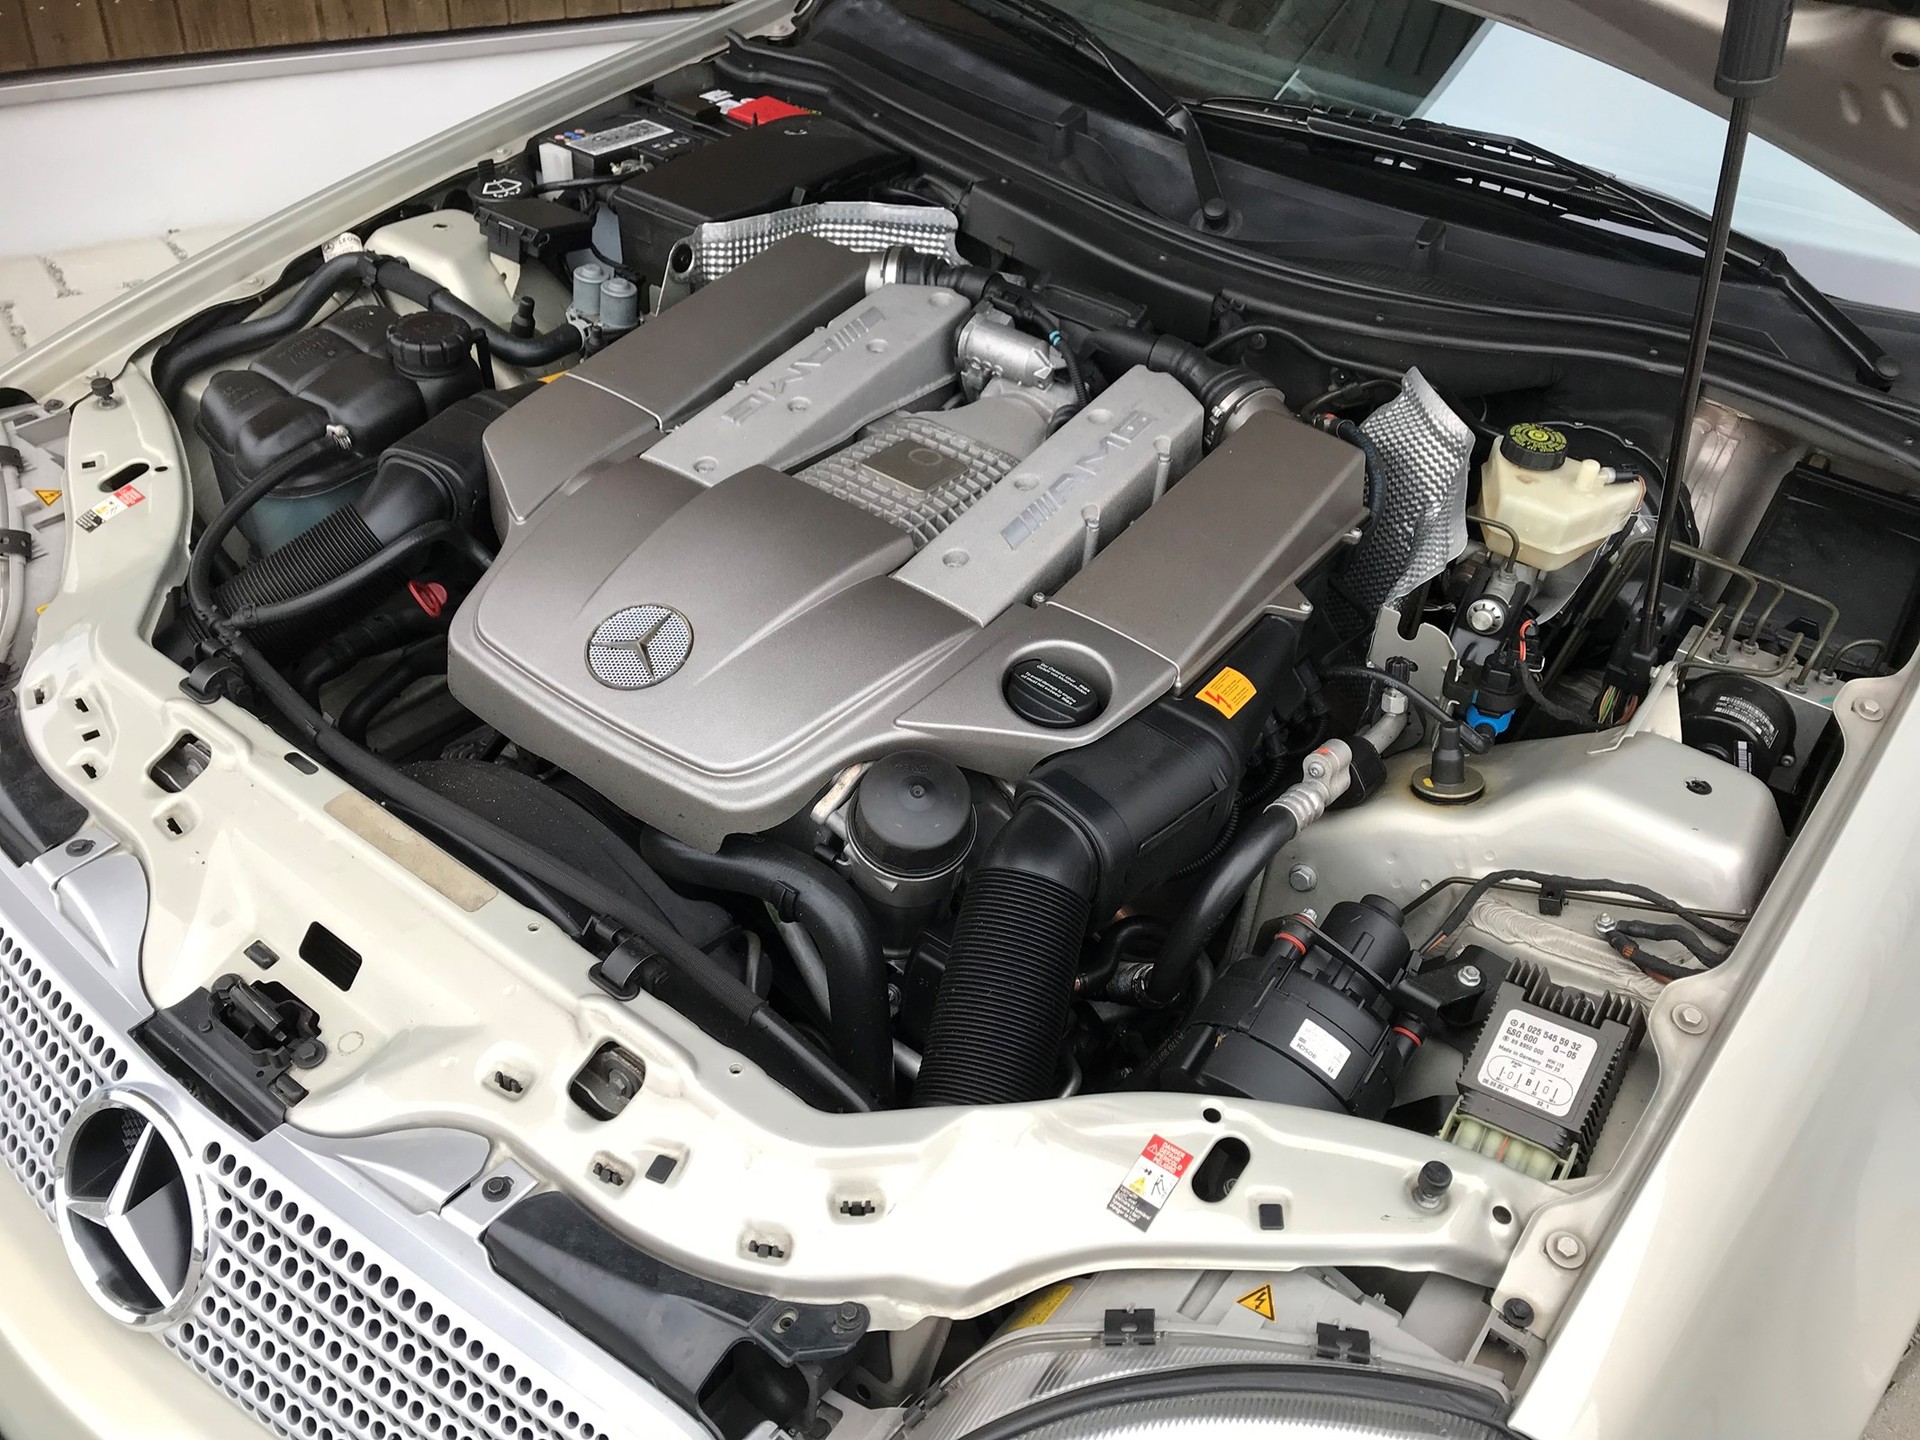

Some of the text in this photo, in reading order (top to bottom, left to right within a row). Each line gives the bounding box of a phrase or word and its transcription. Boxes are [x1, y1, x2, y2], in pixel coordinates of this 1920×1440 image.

[1048, 410, 1156, 504] AMG
[1506, 1027, 1522, 1038] ESG
[1523, 1033, 1538, 1044] 600
[1527, 1025, 1542, 1036] 025
[1543, 1031, 1558, 1042] 545
[1559, 1038, 1570, 1047] 59
[1570, 1042, 1582, 1052] 32
[1296, 1042, 1318, 1060] BOSCH
[1498, 1045, 1512, 1054] Made
[1518, 1052, 1542, 1066] Germany
[1162, 1141, 1186, 1159] DANGER
